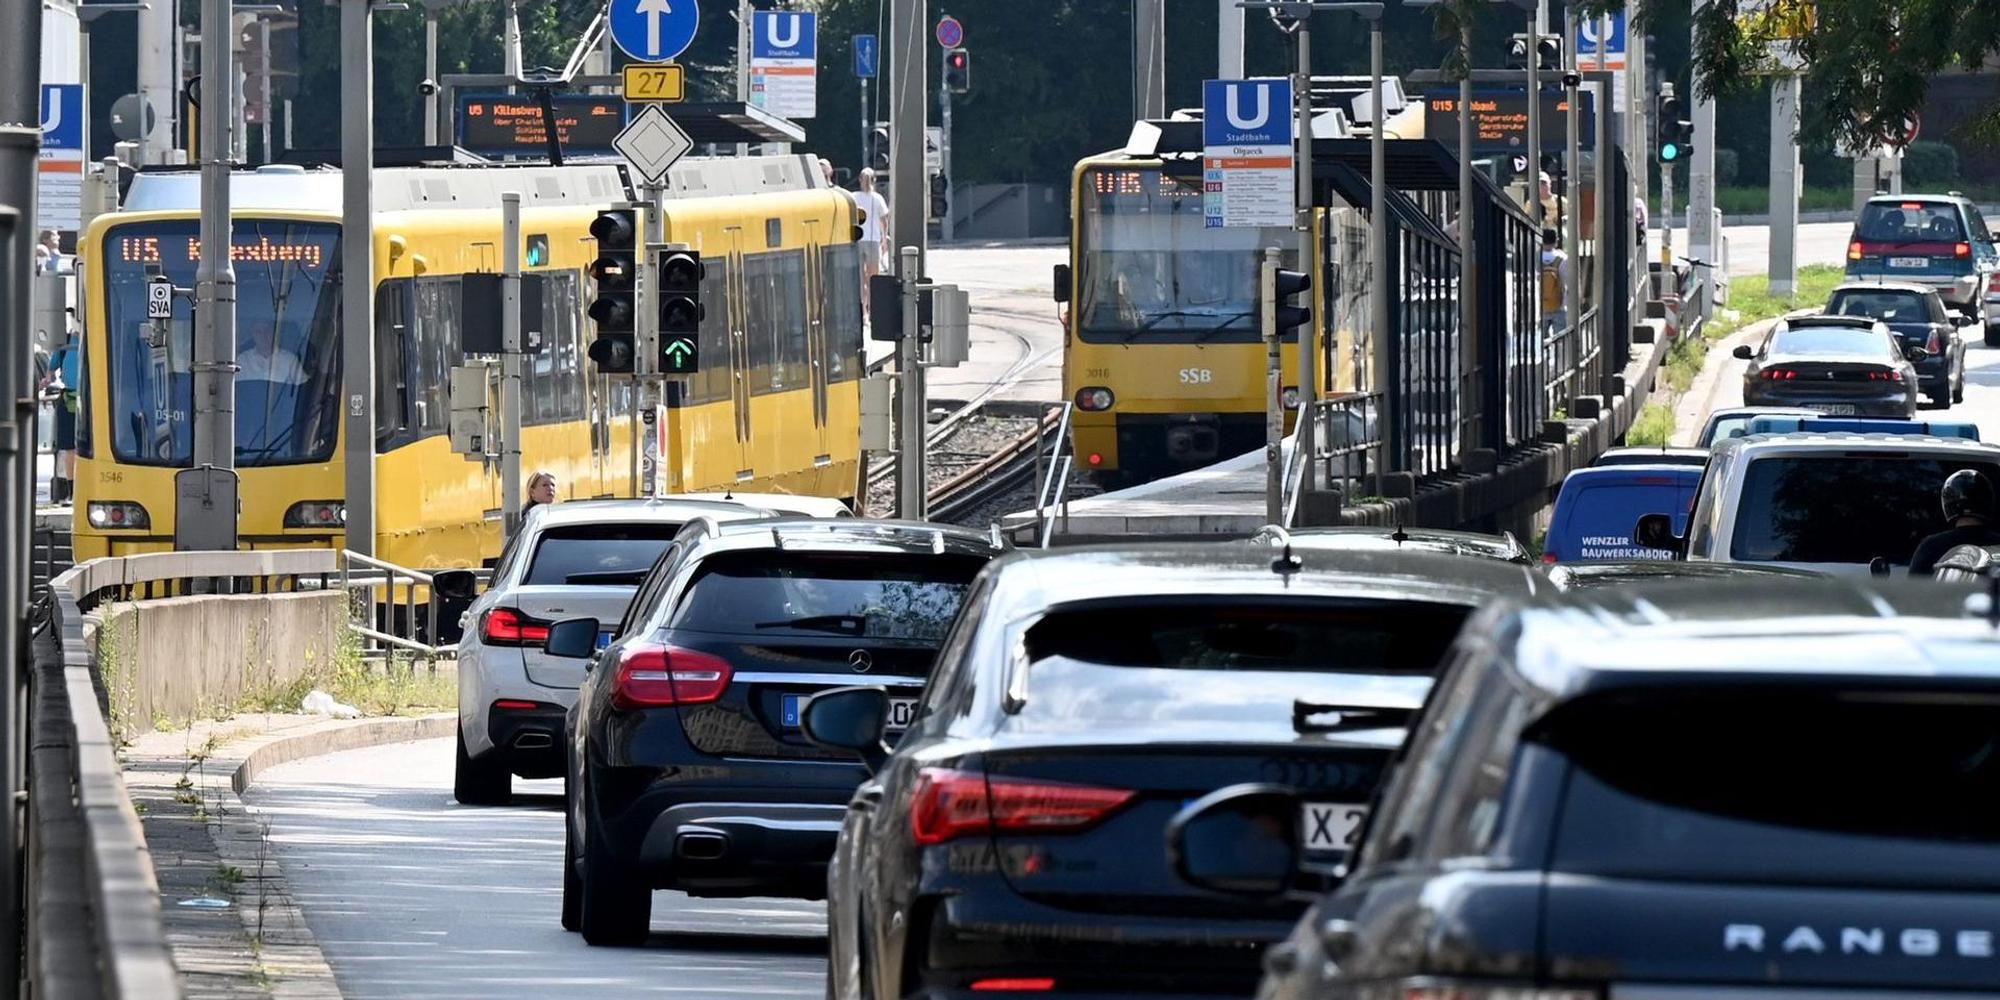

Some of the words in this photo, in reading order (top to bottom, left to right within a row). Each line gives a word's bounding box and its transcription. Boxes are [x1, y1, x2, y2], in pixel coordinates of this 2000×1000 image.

[768, 14, 800, 48] U
[638, 71, 667, 94] 27
[468, 104, 483, 116] U5
[1226, 84, 1269, 129] U
[1432, 100, 1453, 111] U15
[1226, 133, 1270, 142] Stadtbahn
[150, 301, 170, 314] SVA
[1179, 368, 1212, 384] SSB
[1582, 537, 1630, 546] WENZLER
[1723, 924, 1993, 957] RANGE
